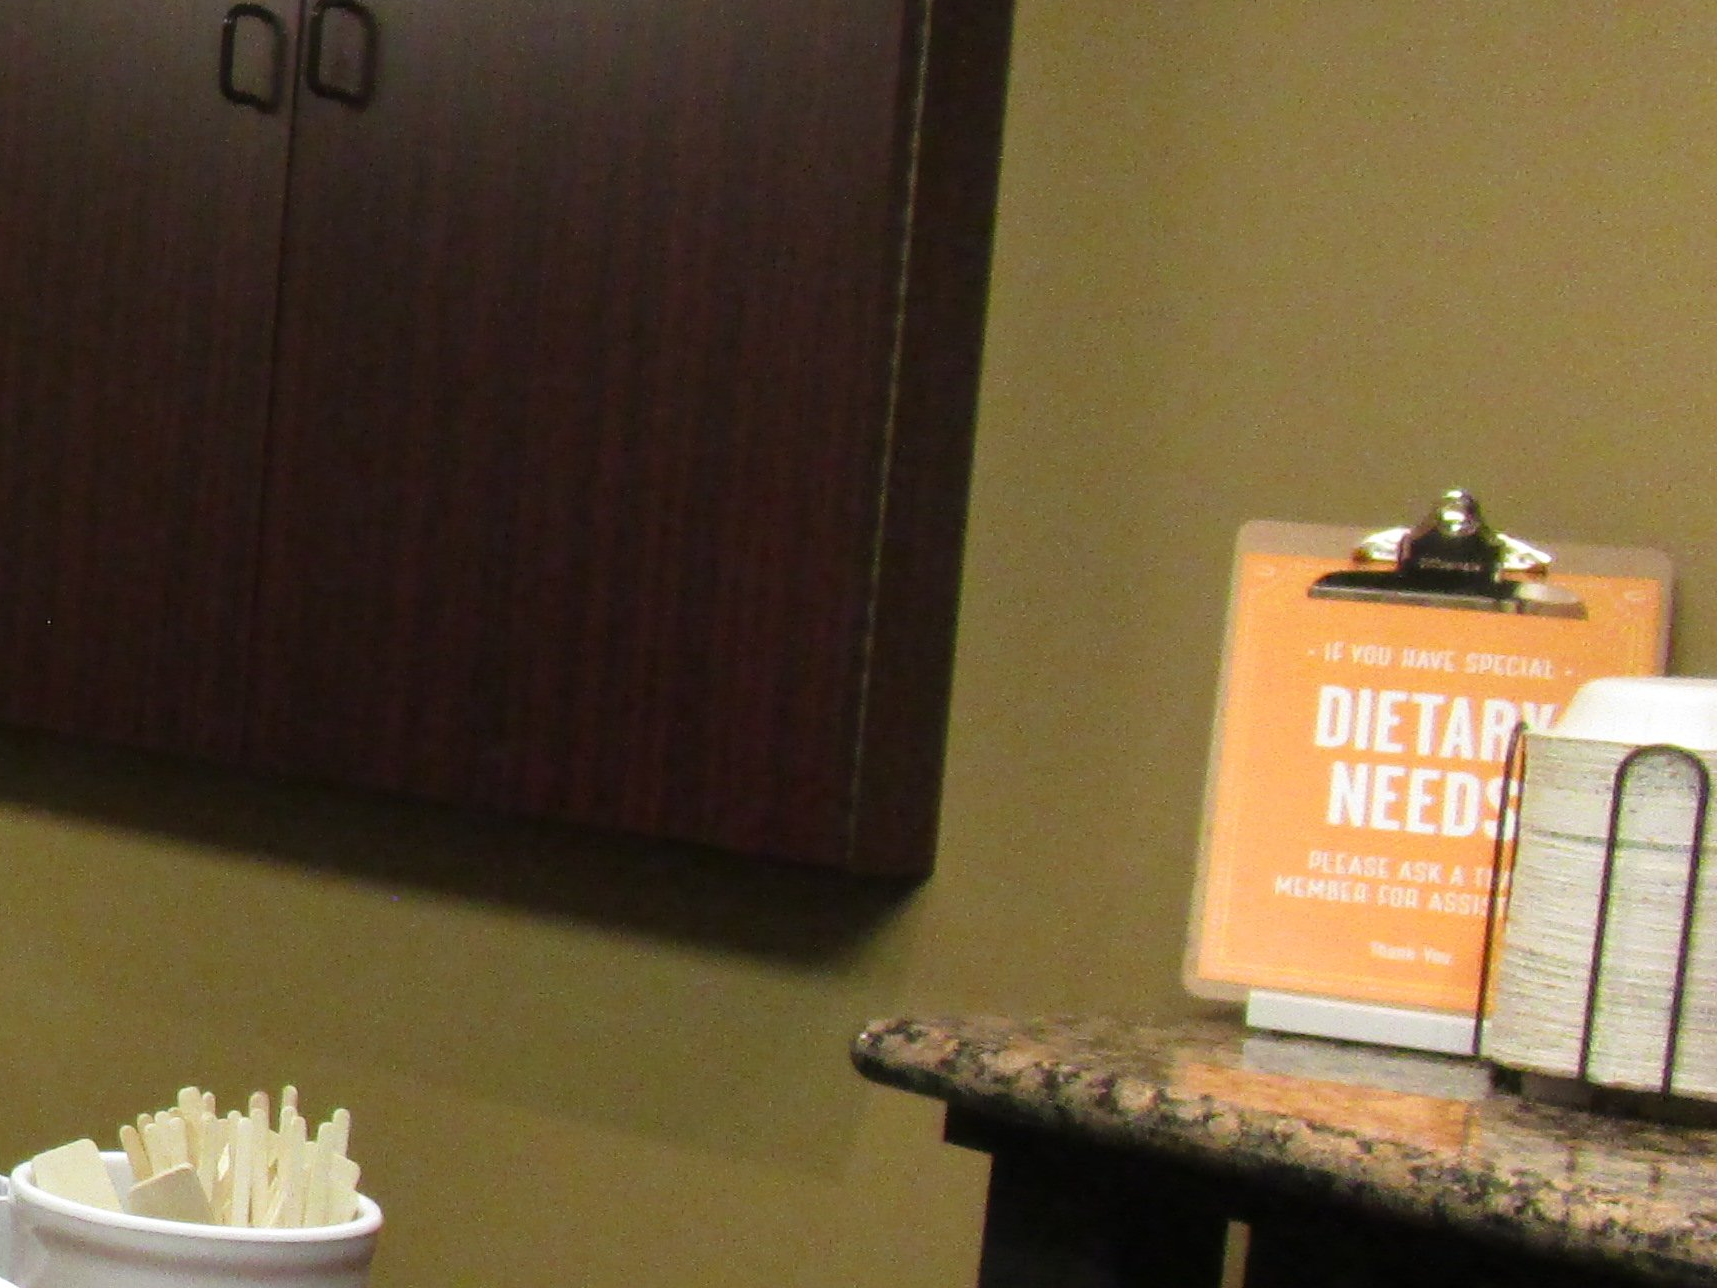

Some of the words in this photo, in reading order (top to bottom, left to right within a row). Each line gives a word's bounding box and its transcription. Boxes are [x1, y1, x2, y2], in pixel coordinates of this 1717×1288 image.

[1324, 641, 1344, 662] IF
[1352, 643, 1393, 666] YOU
[1401, 648, 1455, 673] HAVE
[1465, 652, 1554, 680] SPECIAL
[1315, 684, 1559, 763] DIETARY
[1326, 760, 1519, 842] NEEDS
[1308, 849, 1391, 880] PLEASE
[1397, 861, 1443, 885] ASK
[1449, 865, 1466, 887] A
[1274, 875, 1372, 904] MEMBER
[1376, 884, 1420, 909] FOR
